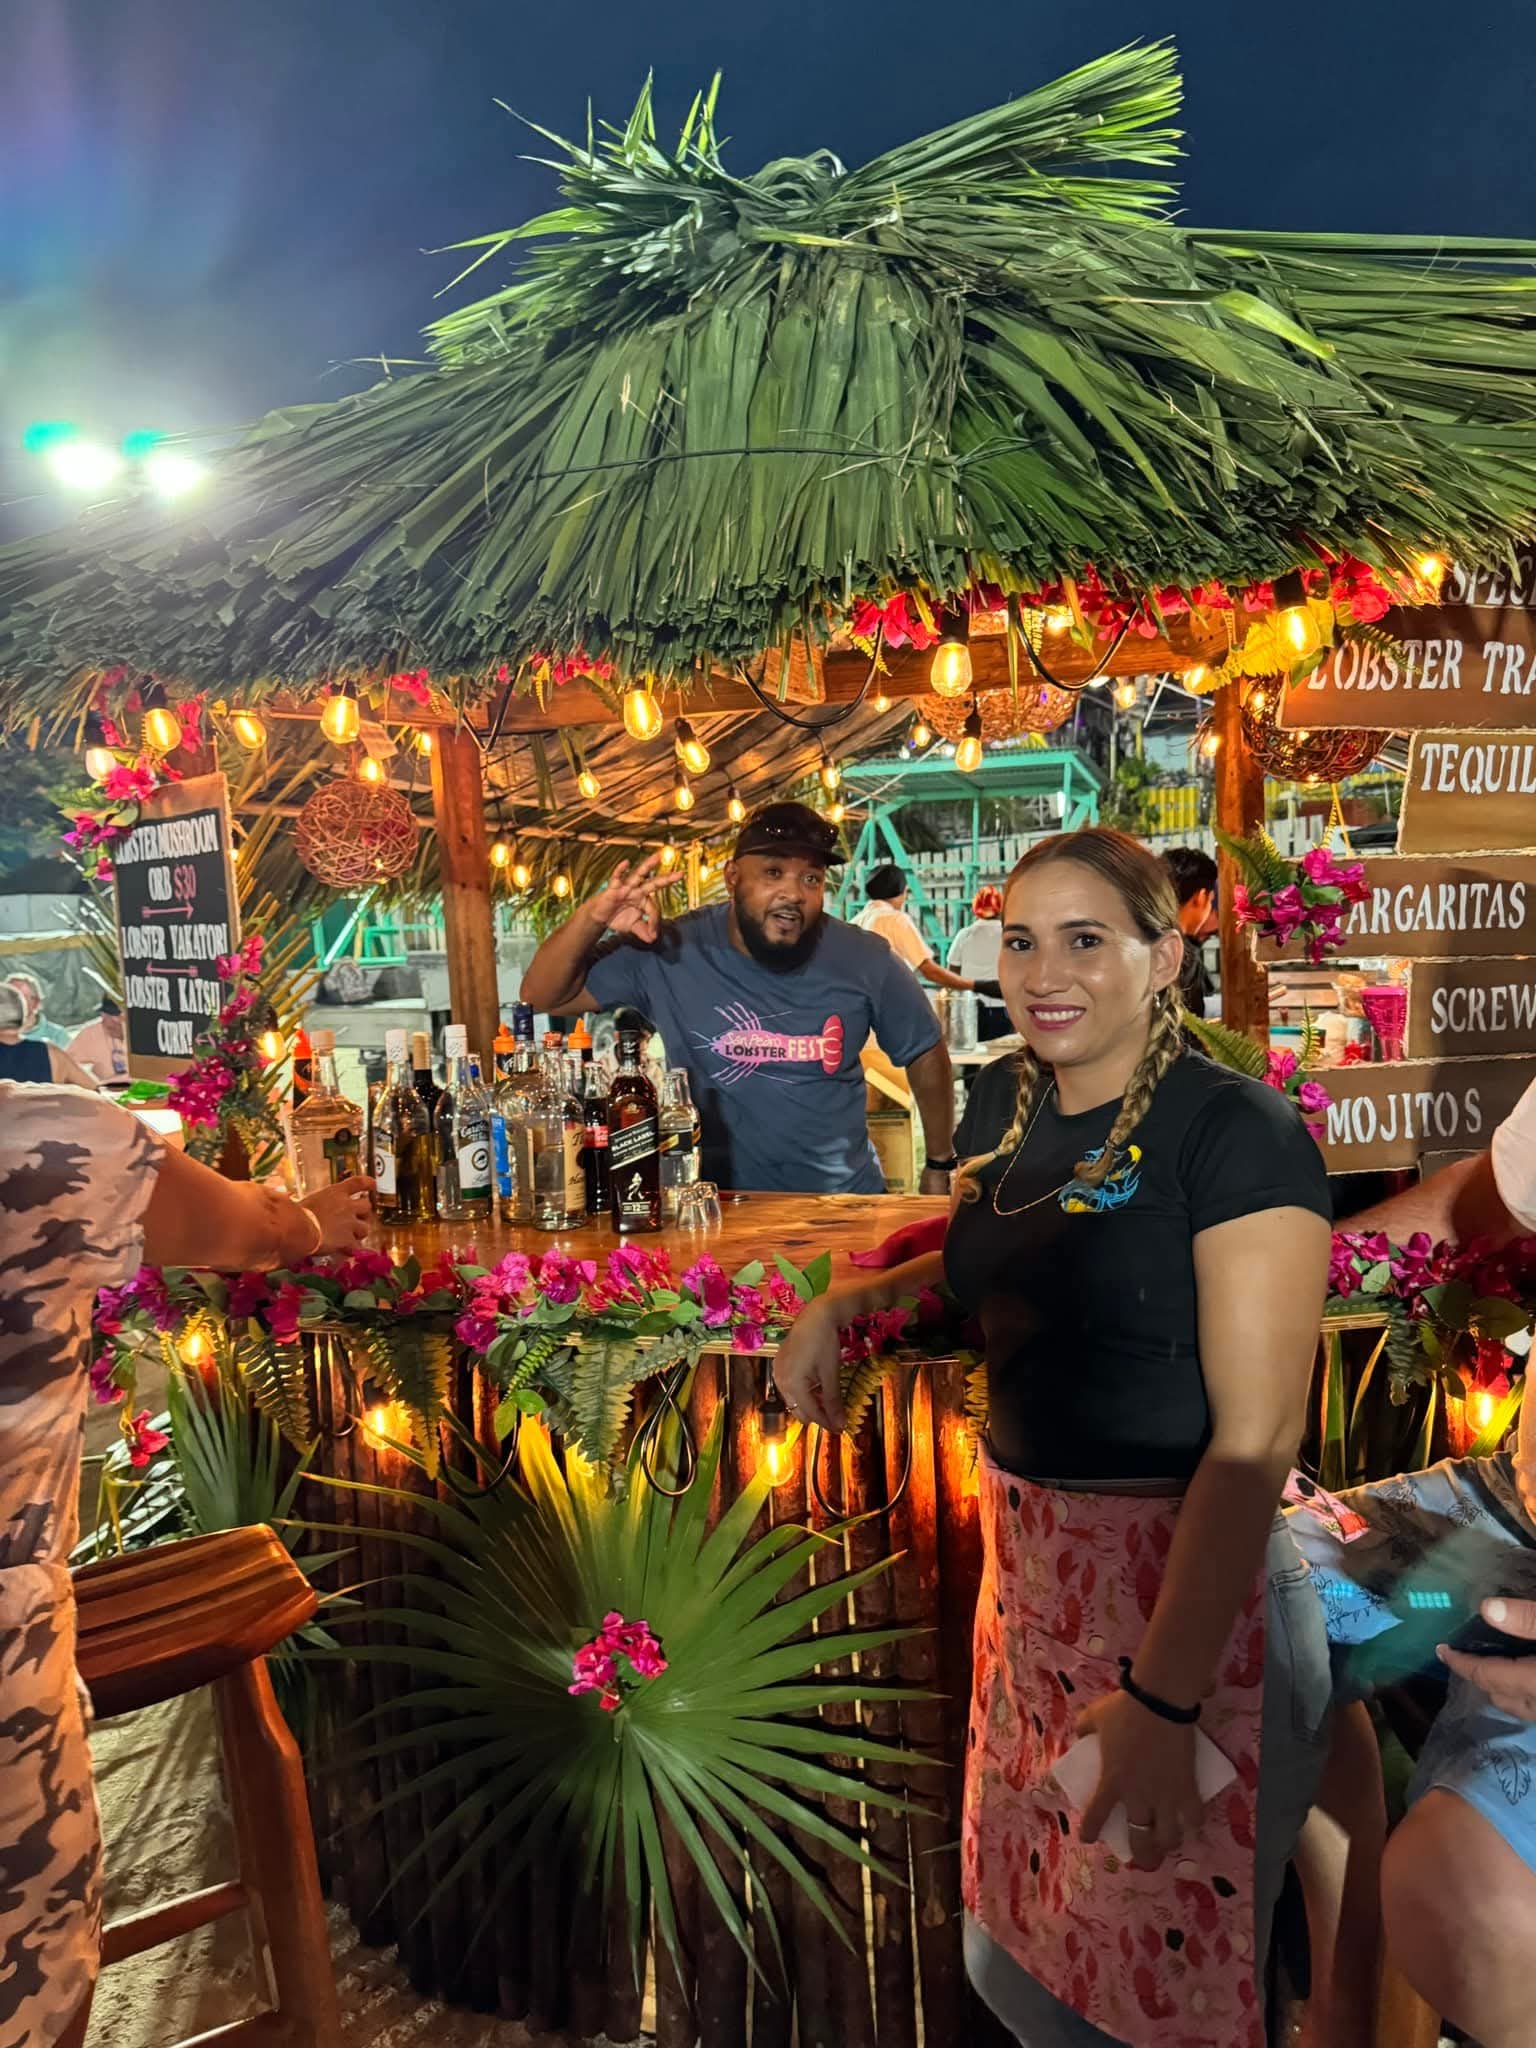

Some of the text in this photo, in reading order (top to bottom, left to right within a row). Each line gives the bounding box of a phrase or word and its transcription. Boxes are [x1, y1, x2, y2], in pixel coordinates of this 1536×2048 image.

[1447, 555, 1536, 605] SPEC
[1420, 743, 1536, 794] TEQUIL
[148, 864, 196, 901] ORB $30
[1335, 881, 1525, 934] ARGARITAS
[121, 923, 228, 960] LOBSTER YAKATORI
[125, 975, 220, 1016] LOBSTER KATSU
[1431, 984, 1536, 1034] SCREW
[725, 1039, 825, 1059] LOBSTER FEST
[1327, 1087, 1482, 1145] MOJITOS
